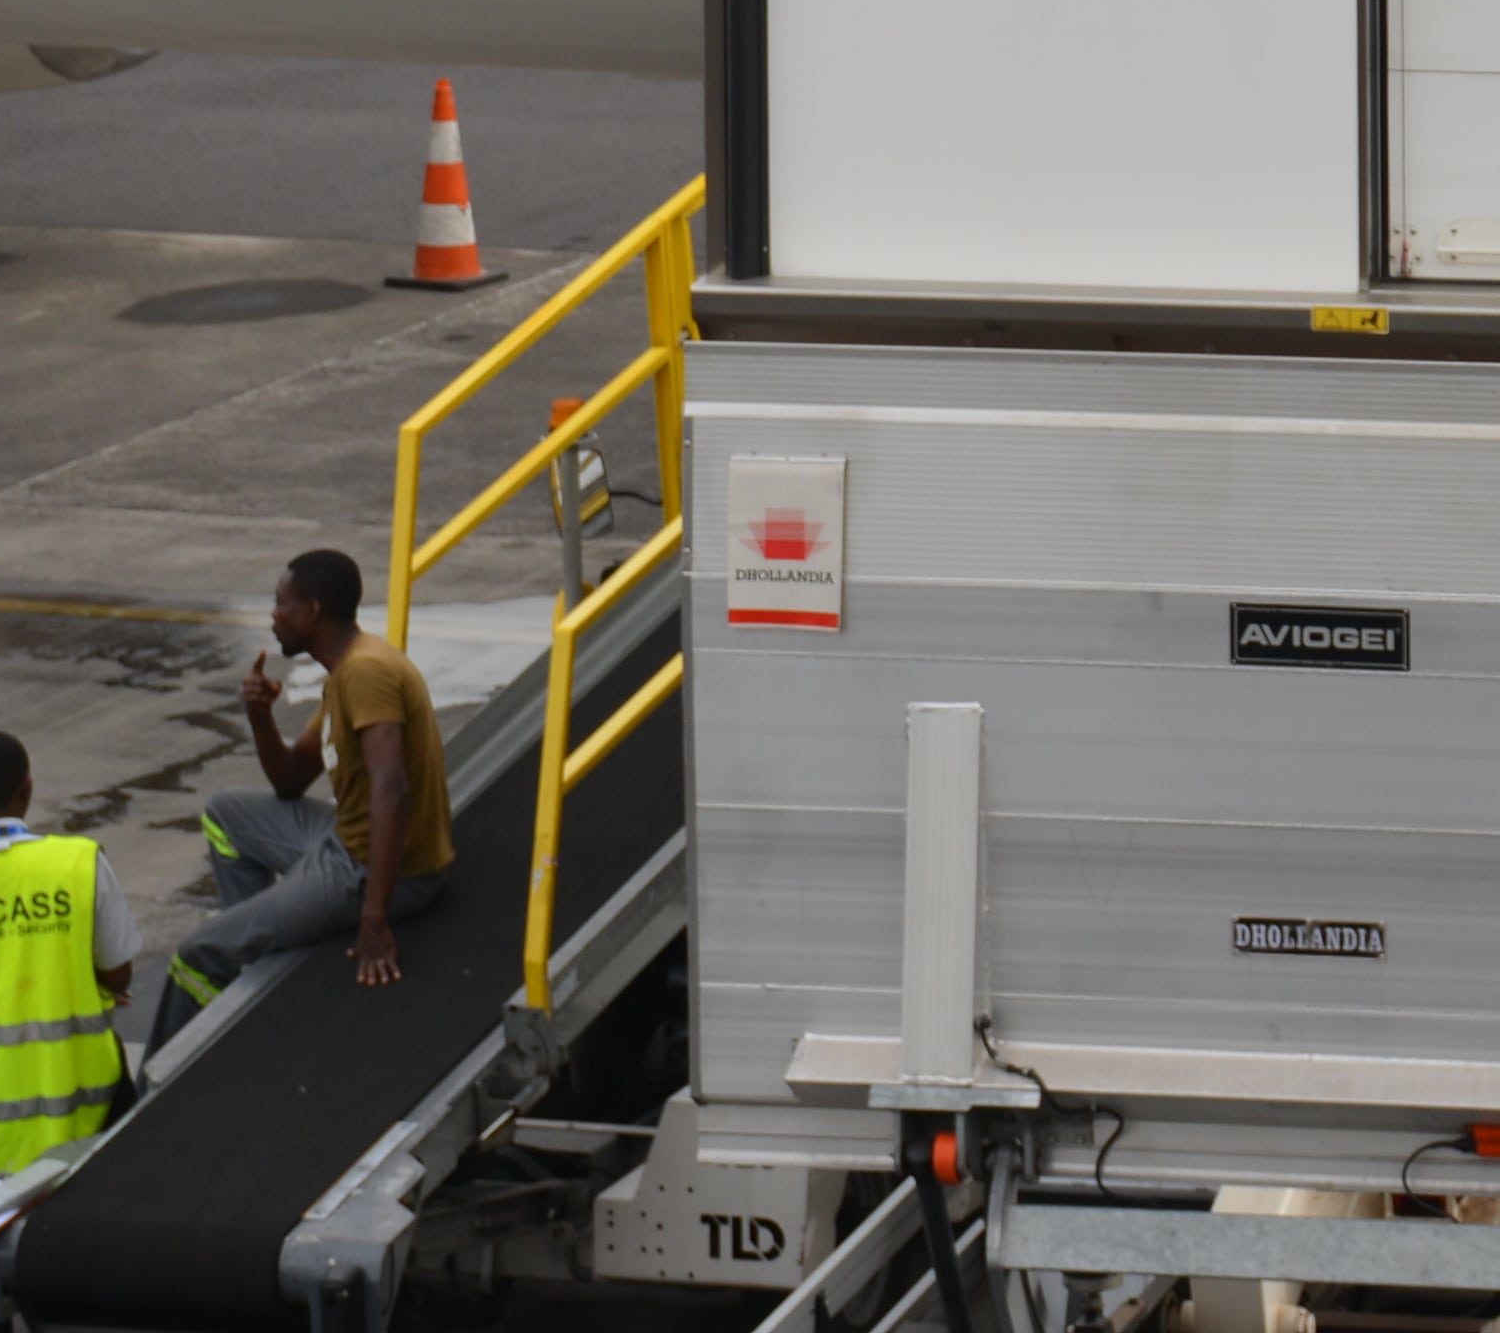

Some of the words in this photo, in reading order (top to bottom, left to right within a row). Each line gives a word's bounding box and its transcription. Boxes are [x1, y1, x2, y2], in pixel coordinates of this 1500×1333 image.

[735, 569, 835, 585] DHOLLANDIA
[1239, 623, 1396, 652] AVIOGEI
[1235, 923, 1383, 952] DHOLLANDIA
[700, 1214, 786, 1262] TLD
